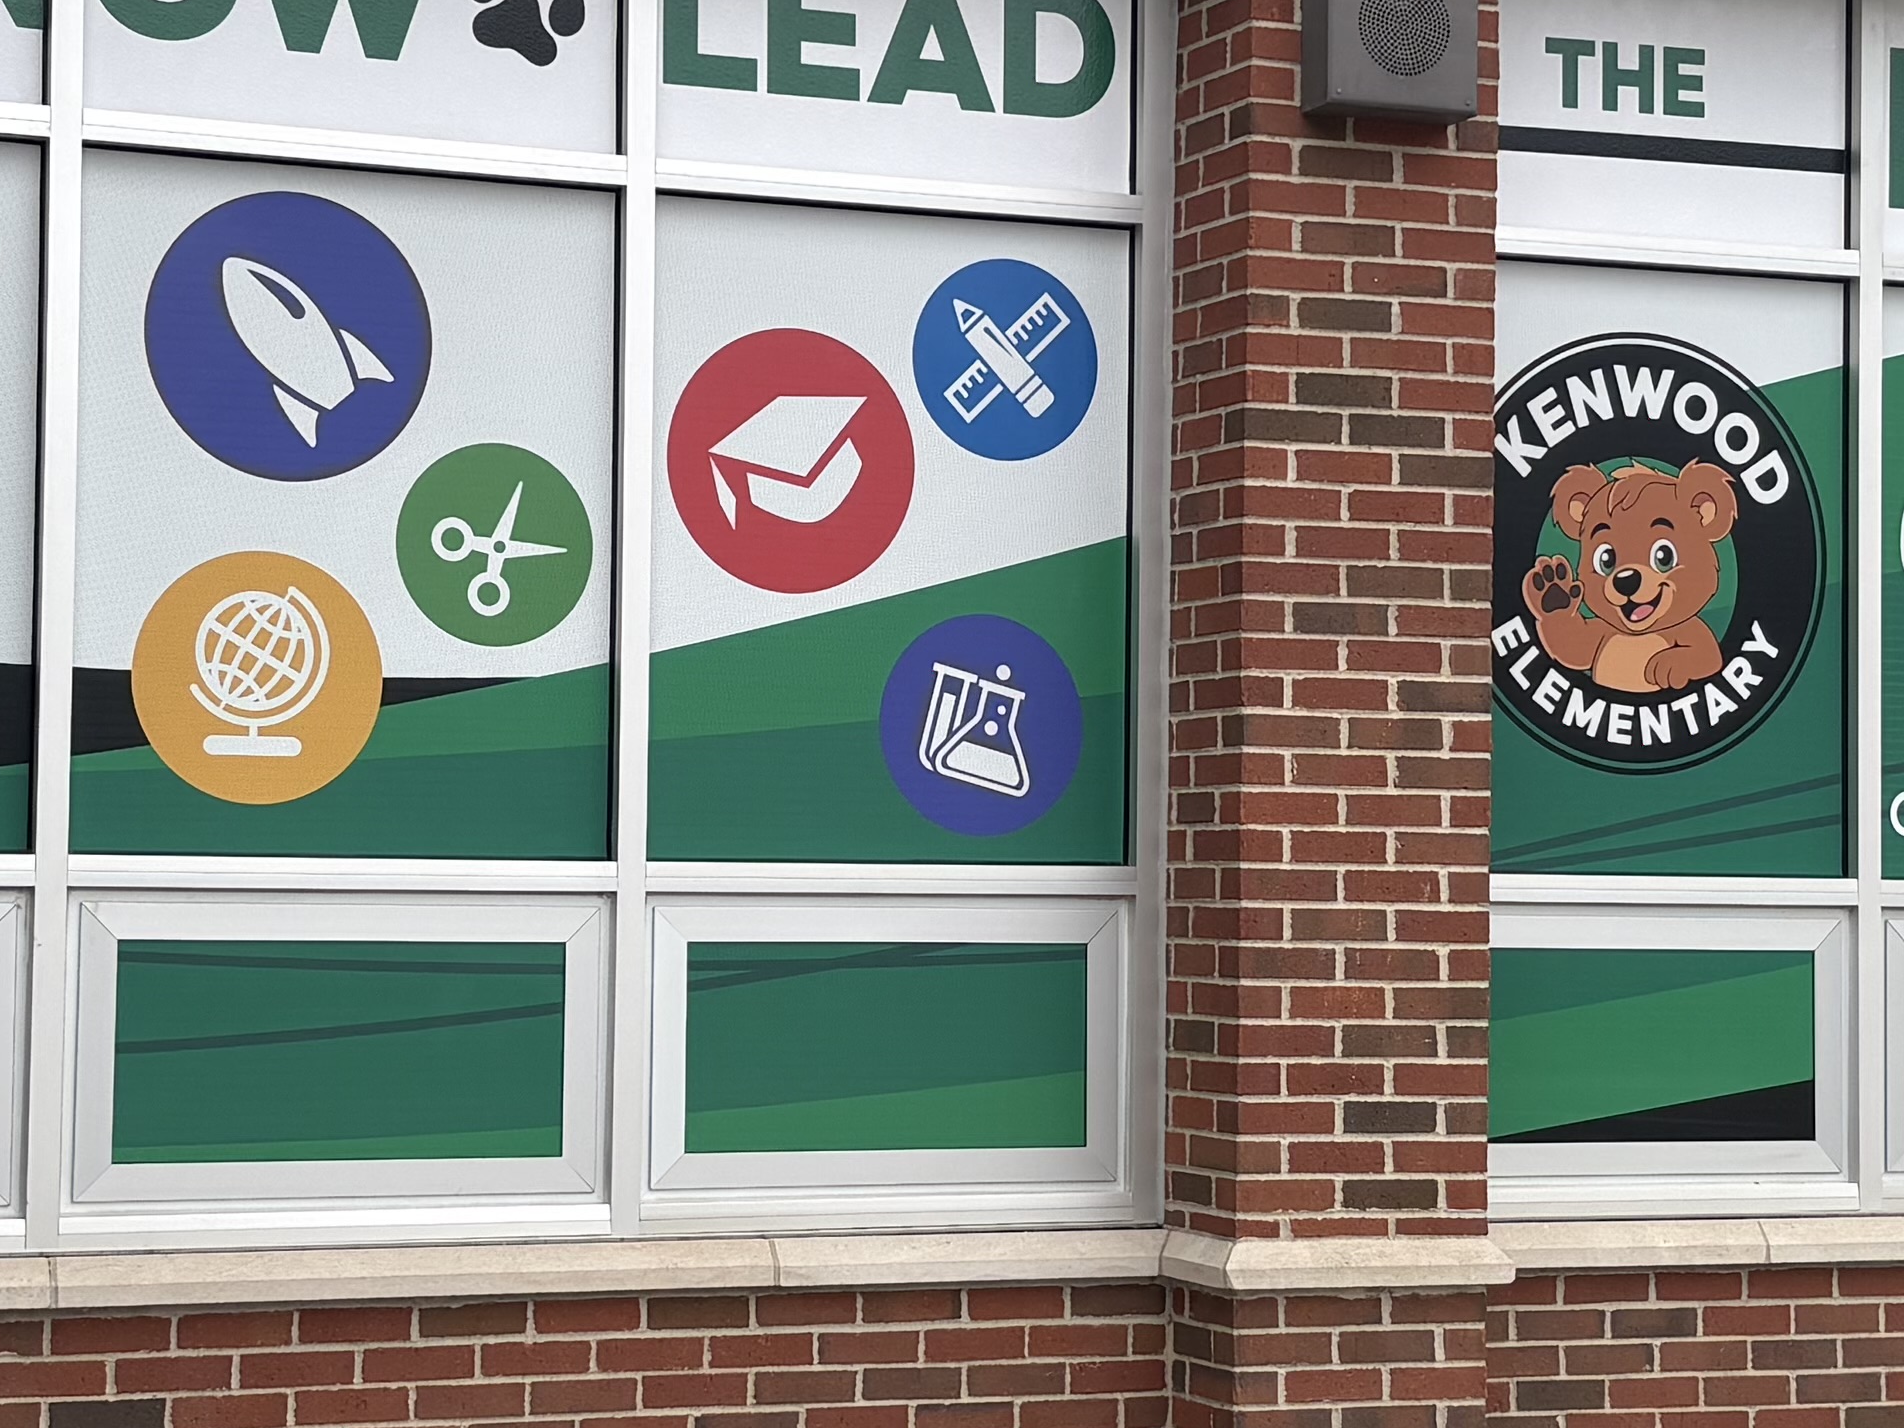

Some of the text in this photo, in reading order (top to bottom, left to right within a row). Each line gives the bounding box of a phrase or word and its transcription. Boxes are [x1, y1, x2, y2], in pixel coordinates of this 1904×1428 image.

[1545, 36, 1706, 119] THE
[1494, 364, 1790, 506] KENWOOD
[1491, 615, 1780, 747] ELEMENTARY
